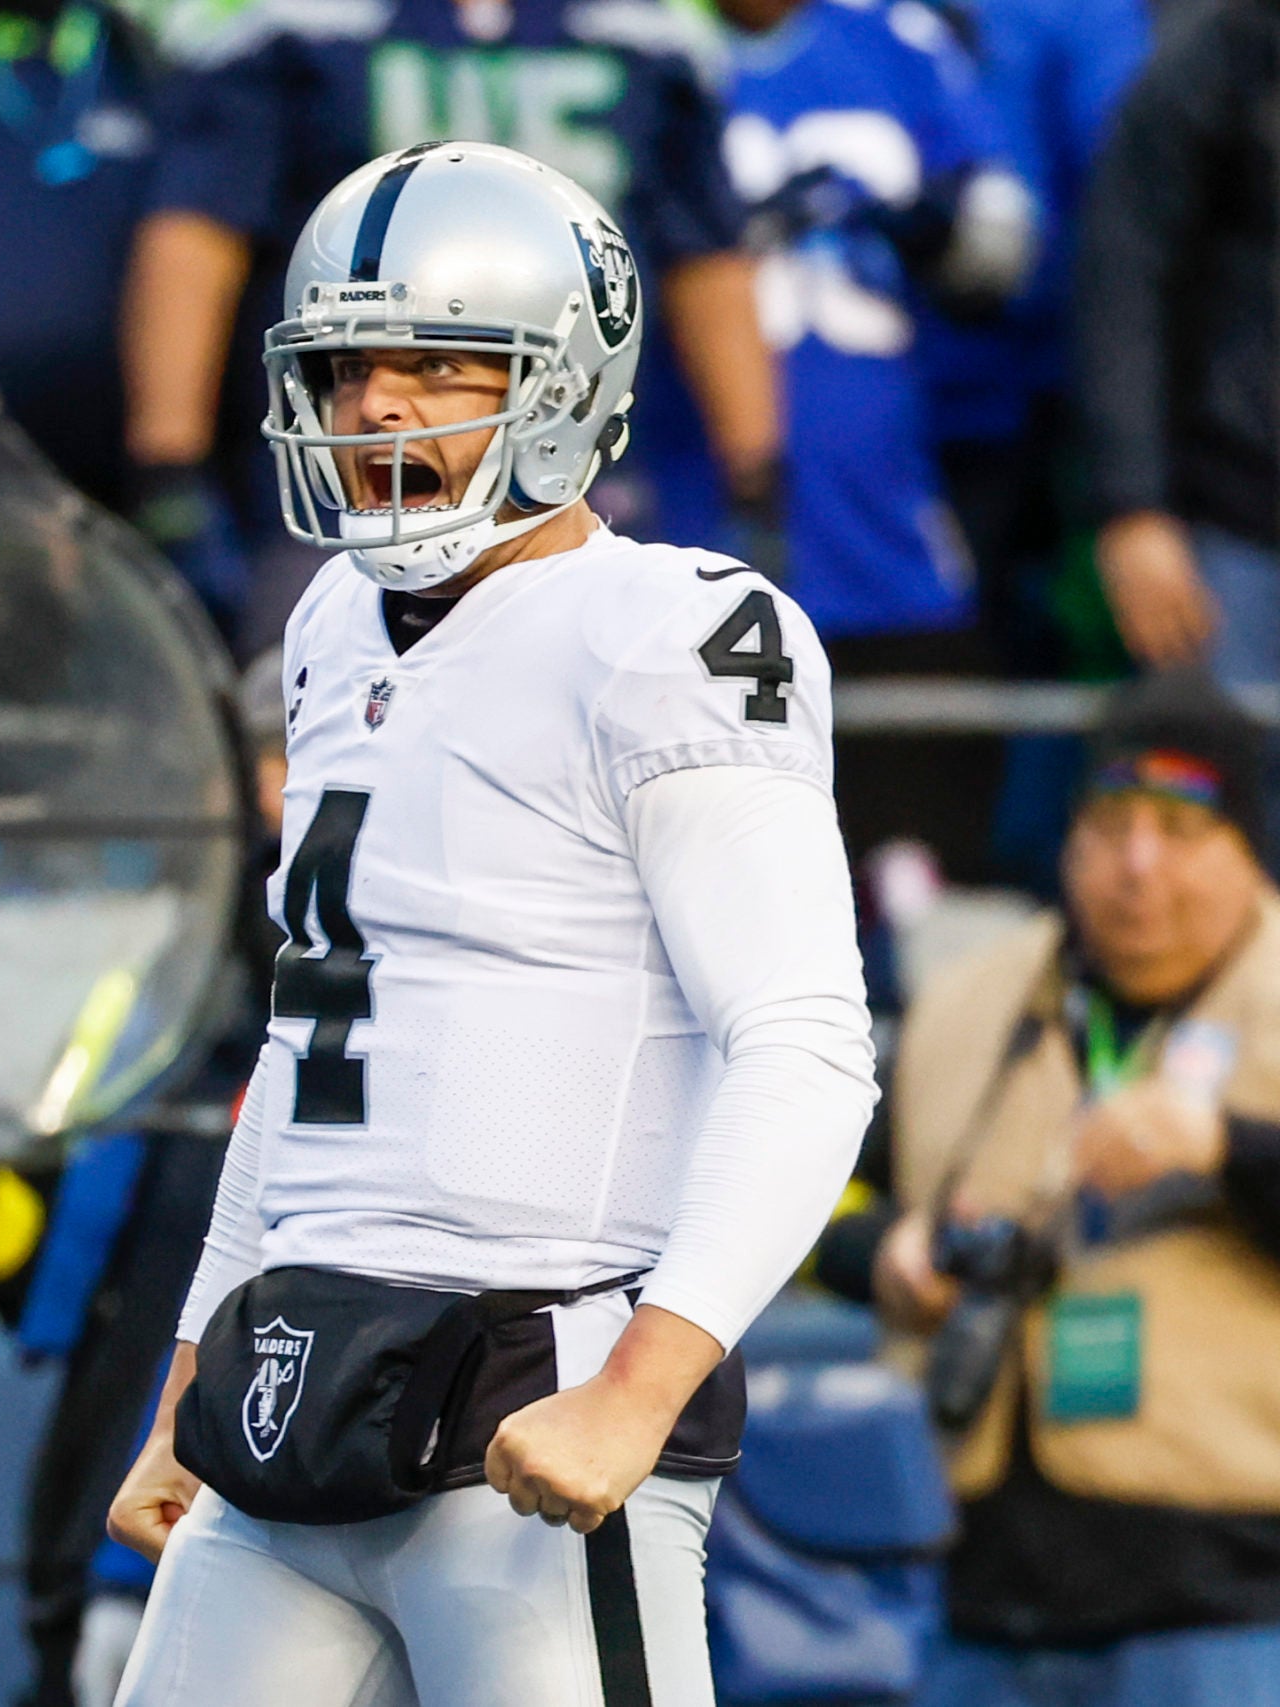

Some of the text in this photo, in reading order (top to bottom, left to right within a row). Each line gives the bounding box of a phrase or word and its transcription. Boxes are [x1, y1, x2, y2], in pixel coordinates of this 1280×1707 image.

[339, 290, 386, 302] RAIDERS
[693, 588, 794, 728] 4
[273, 784, 376, 1130] 4
